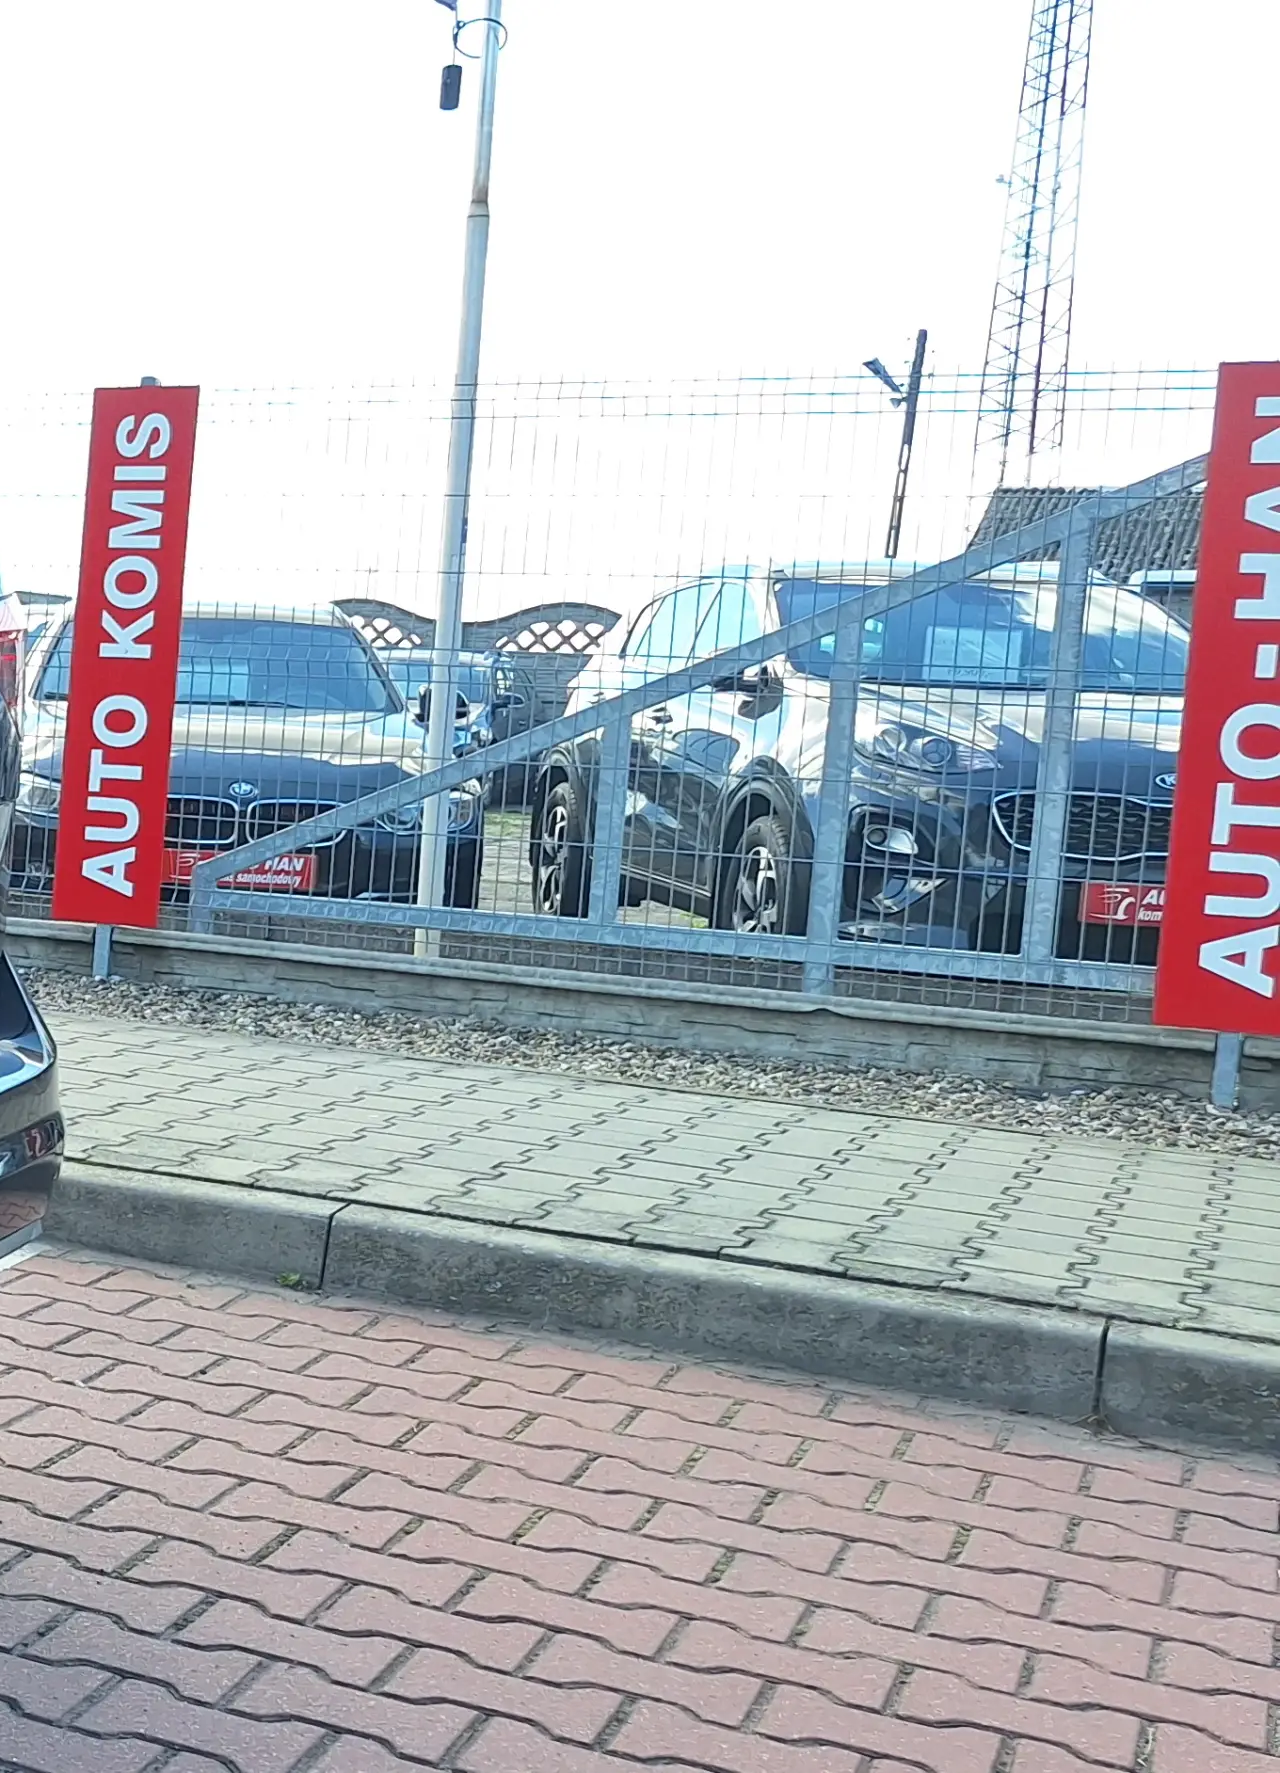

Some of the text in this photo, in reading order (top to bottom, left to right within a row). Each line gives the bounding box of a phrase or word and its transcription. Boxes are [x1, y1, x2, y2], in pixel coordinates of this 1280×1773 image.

[80, 411, 173, 898] AUTO KOMIS
[1137, 906, 1164, 922] kom
